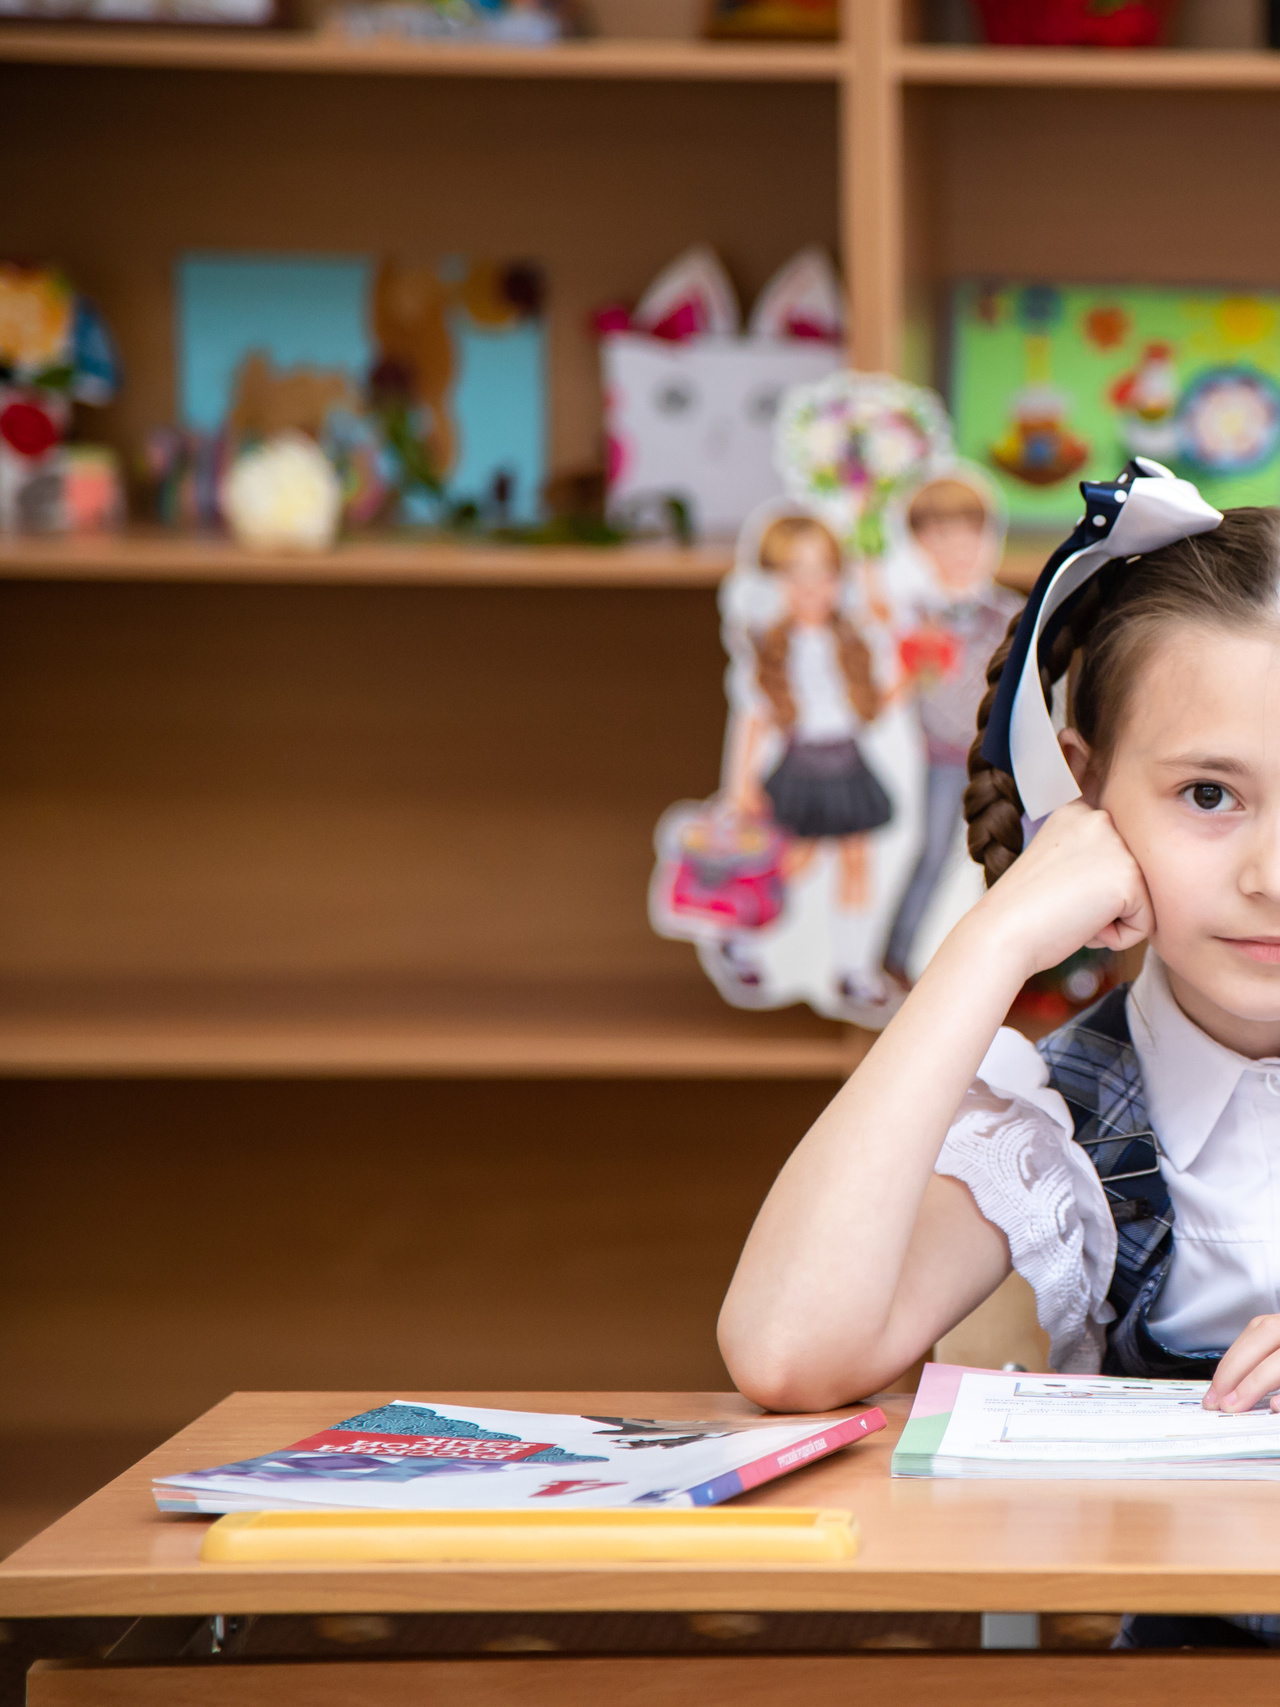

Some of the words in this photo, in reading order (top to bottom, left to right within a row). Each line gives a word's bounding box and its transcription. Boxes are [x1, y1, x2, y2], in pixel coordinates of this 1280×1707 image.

[348, 1440, 524, 1456] РОДНОЙ
[422, 1437, 536, 1449] ЯЗЫК
[313, 1444, 511, 1460] РУССКИЙ
[528, 1479, 629, 1499] 4
